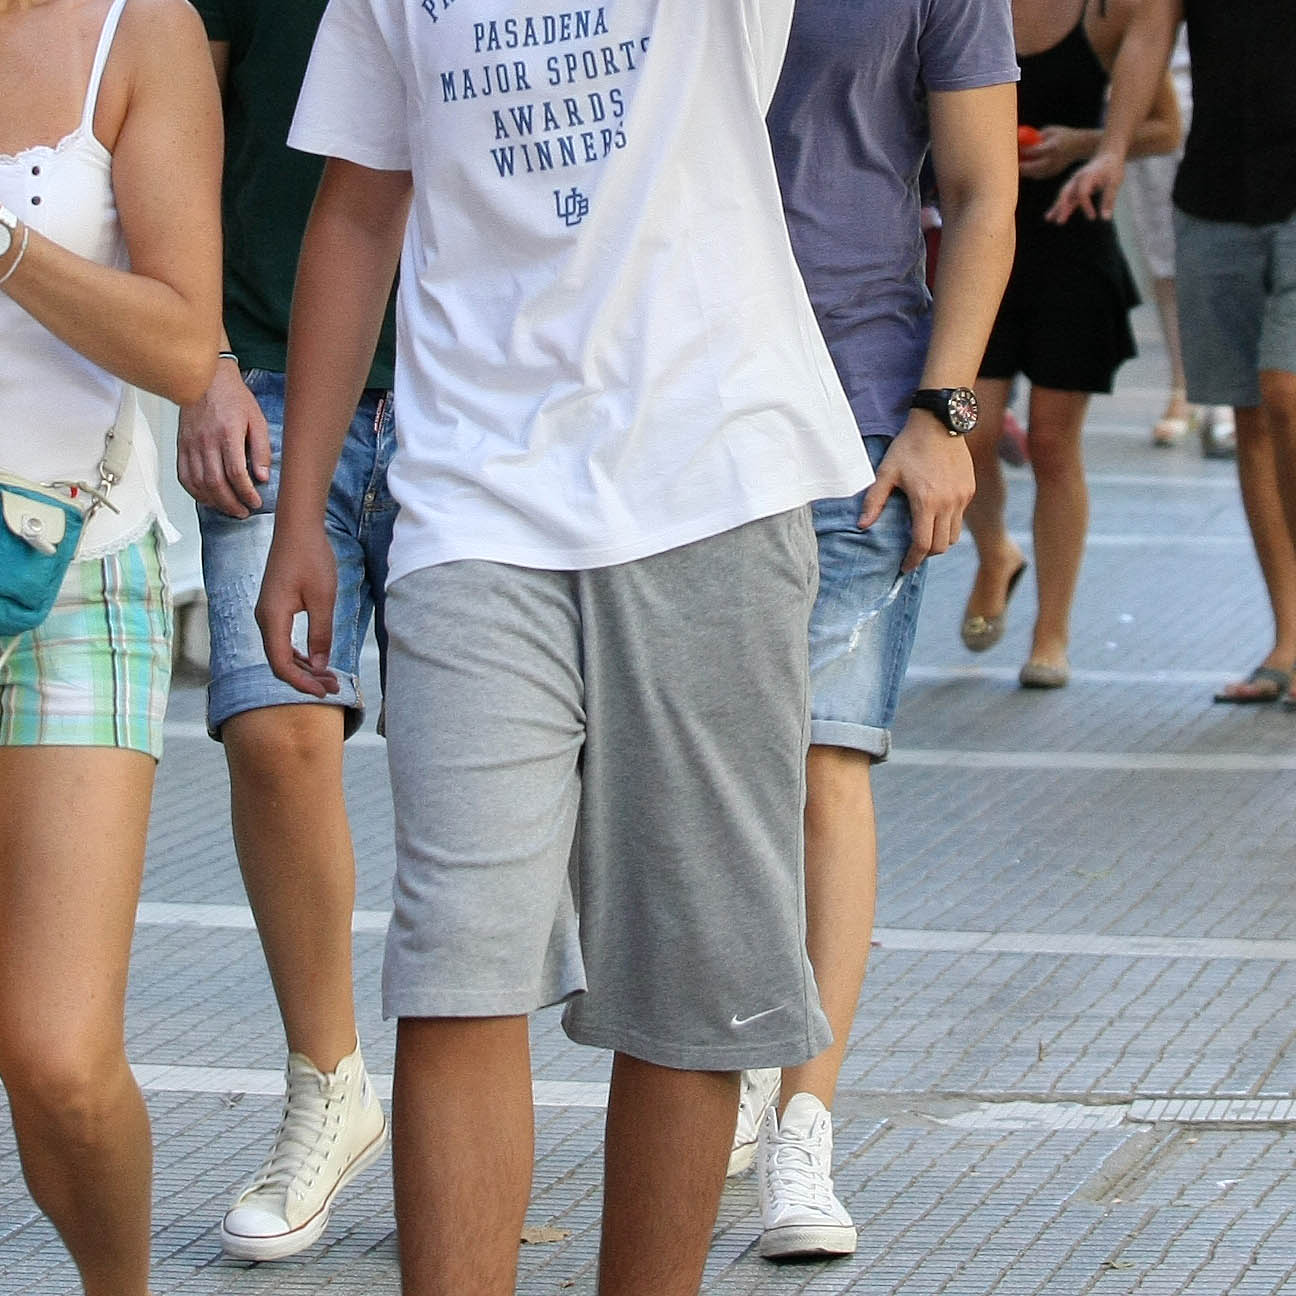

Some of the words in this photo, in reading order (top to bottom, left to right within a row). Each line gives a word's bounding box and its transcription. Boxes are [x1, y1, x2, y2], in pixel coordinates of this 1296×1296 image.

[473, 7, 609, 53] PASADENA
[440, 61, 531, 103] MAJOR
[492, 88, 625, 140] AWARDS
[490, 122, 627, 178] WINNERS
